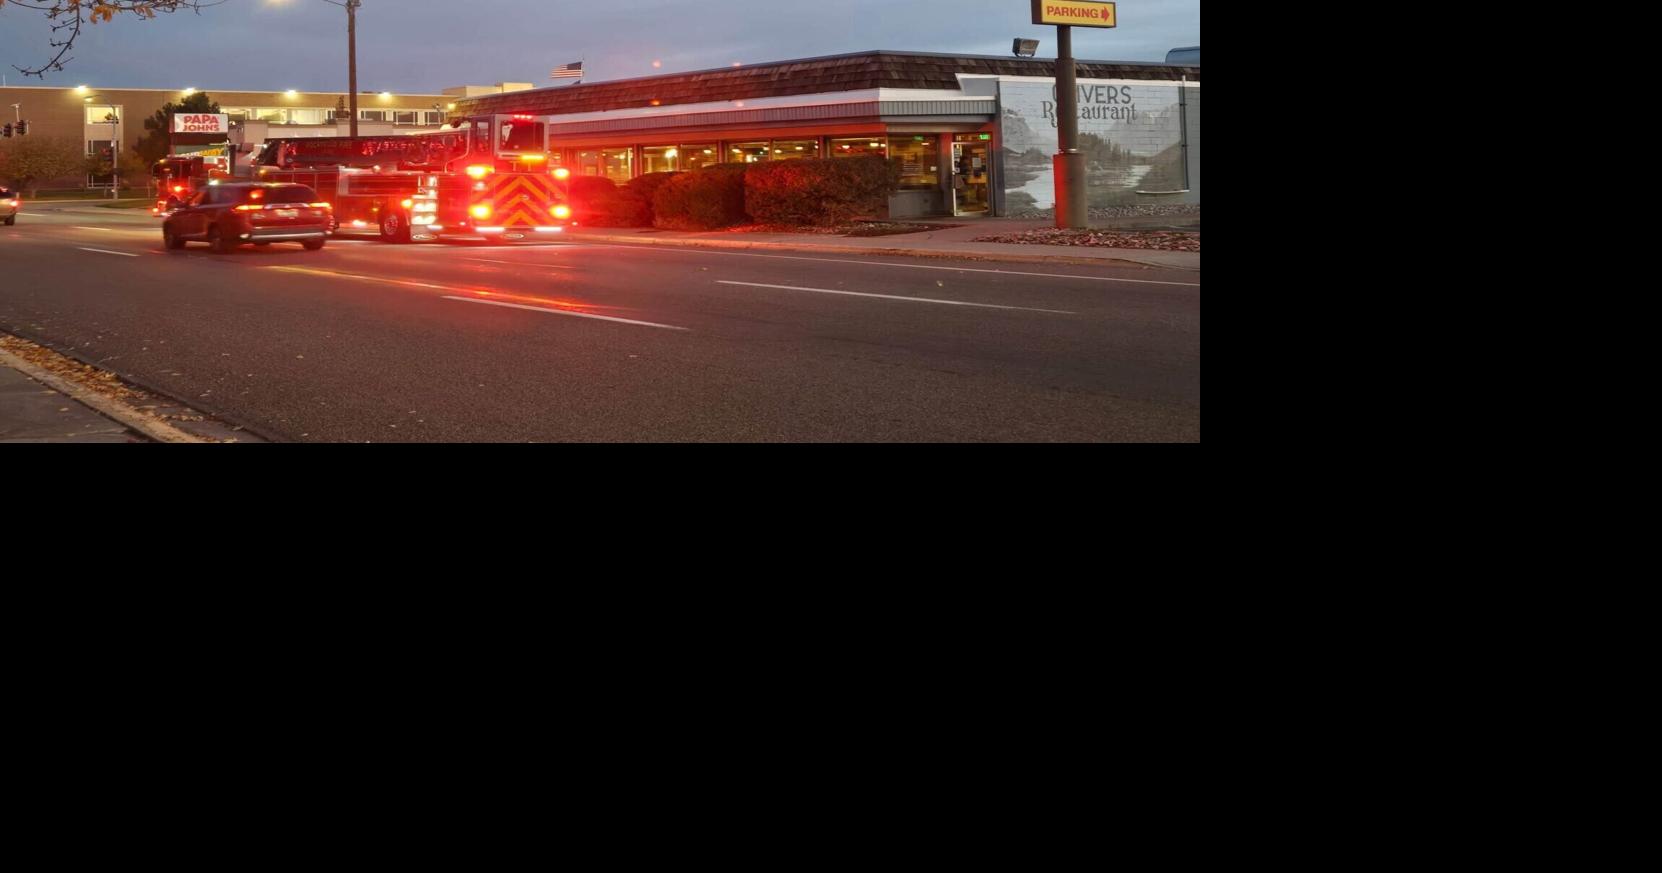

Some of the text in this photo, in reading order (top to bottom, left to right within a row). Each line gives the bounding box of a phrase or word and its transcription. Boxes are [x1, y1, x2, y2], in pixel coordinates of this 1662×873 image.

[1046, 6, 1098, 18] PARKING
[1052, 85, 1132, 104] IVERS
[183, 115, 219, 124] PAPA
[1040, 100, 1137, 128] Raurant
